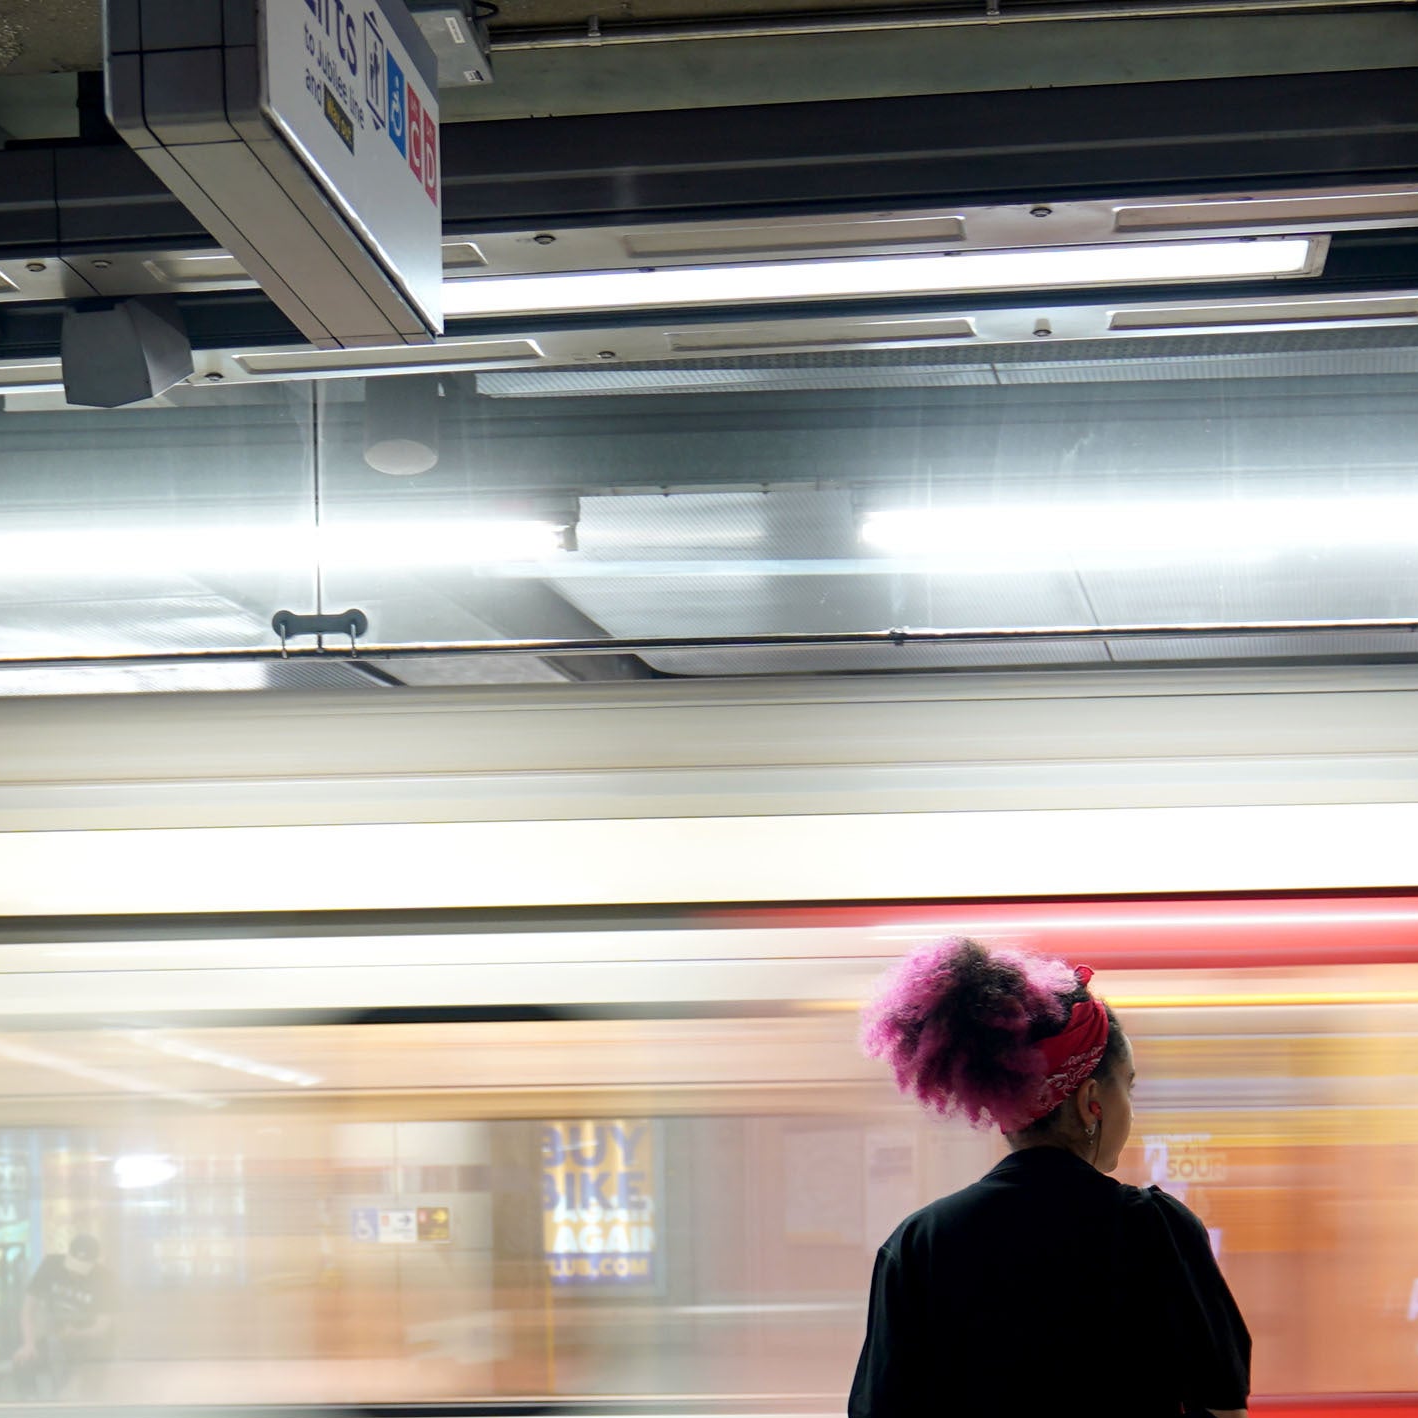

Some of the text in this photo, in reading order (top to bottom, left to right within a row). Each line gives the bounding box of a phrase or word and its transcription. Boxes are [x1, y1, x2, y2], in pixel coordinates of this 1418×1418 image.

[304, 22, 364, 130] to Jubilee line
[305, 67, 322, 108] and
[411, 121, 421, 168] C
[425, 143, 435, 188] D
